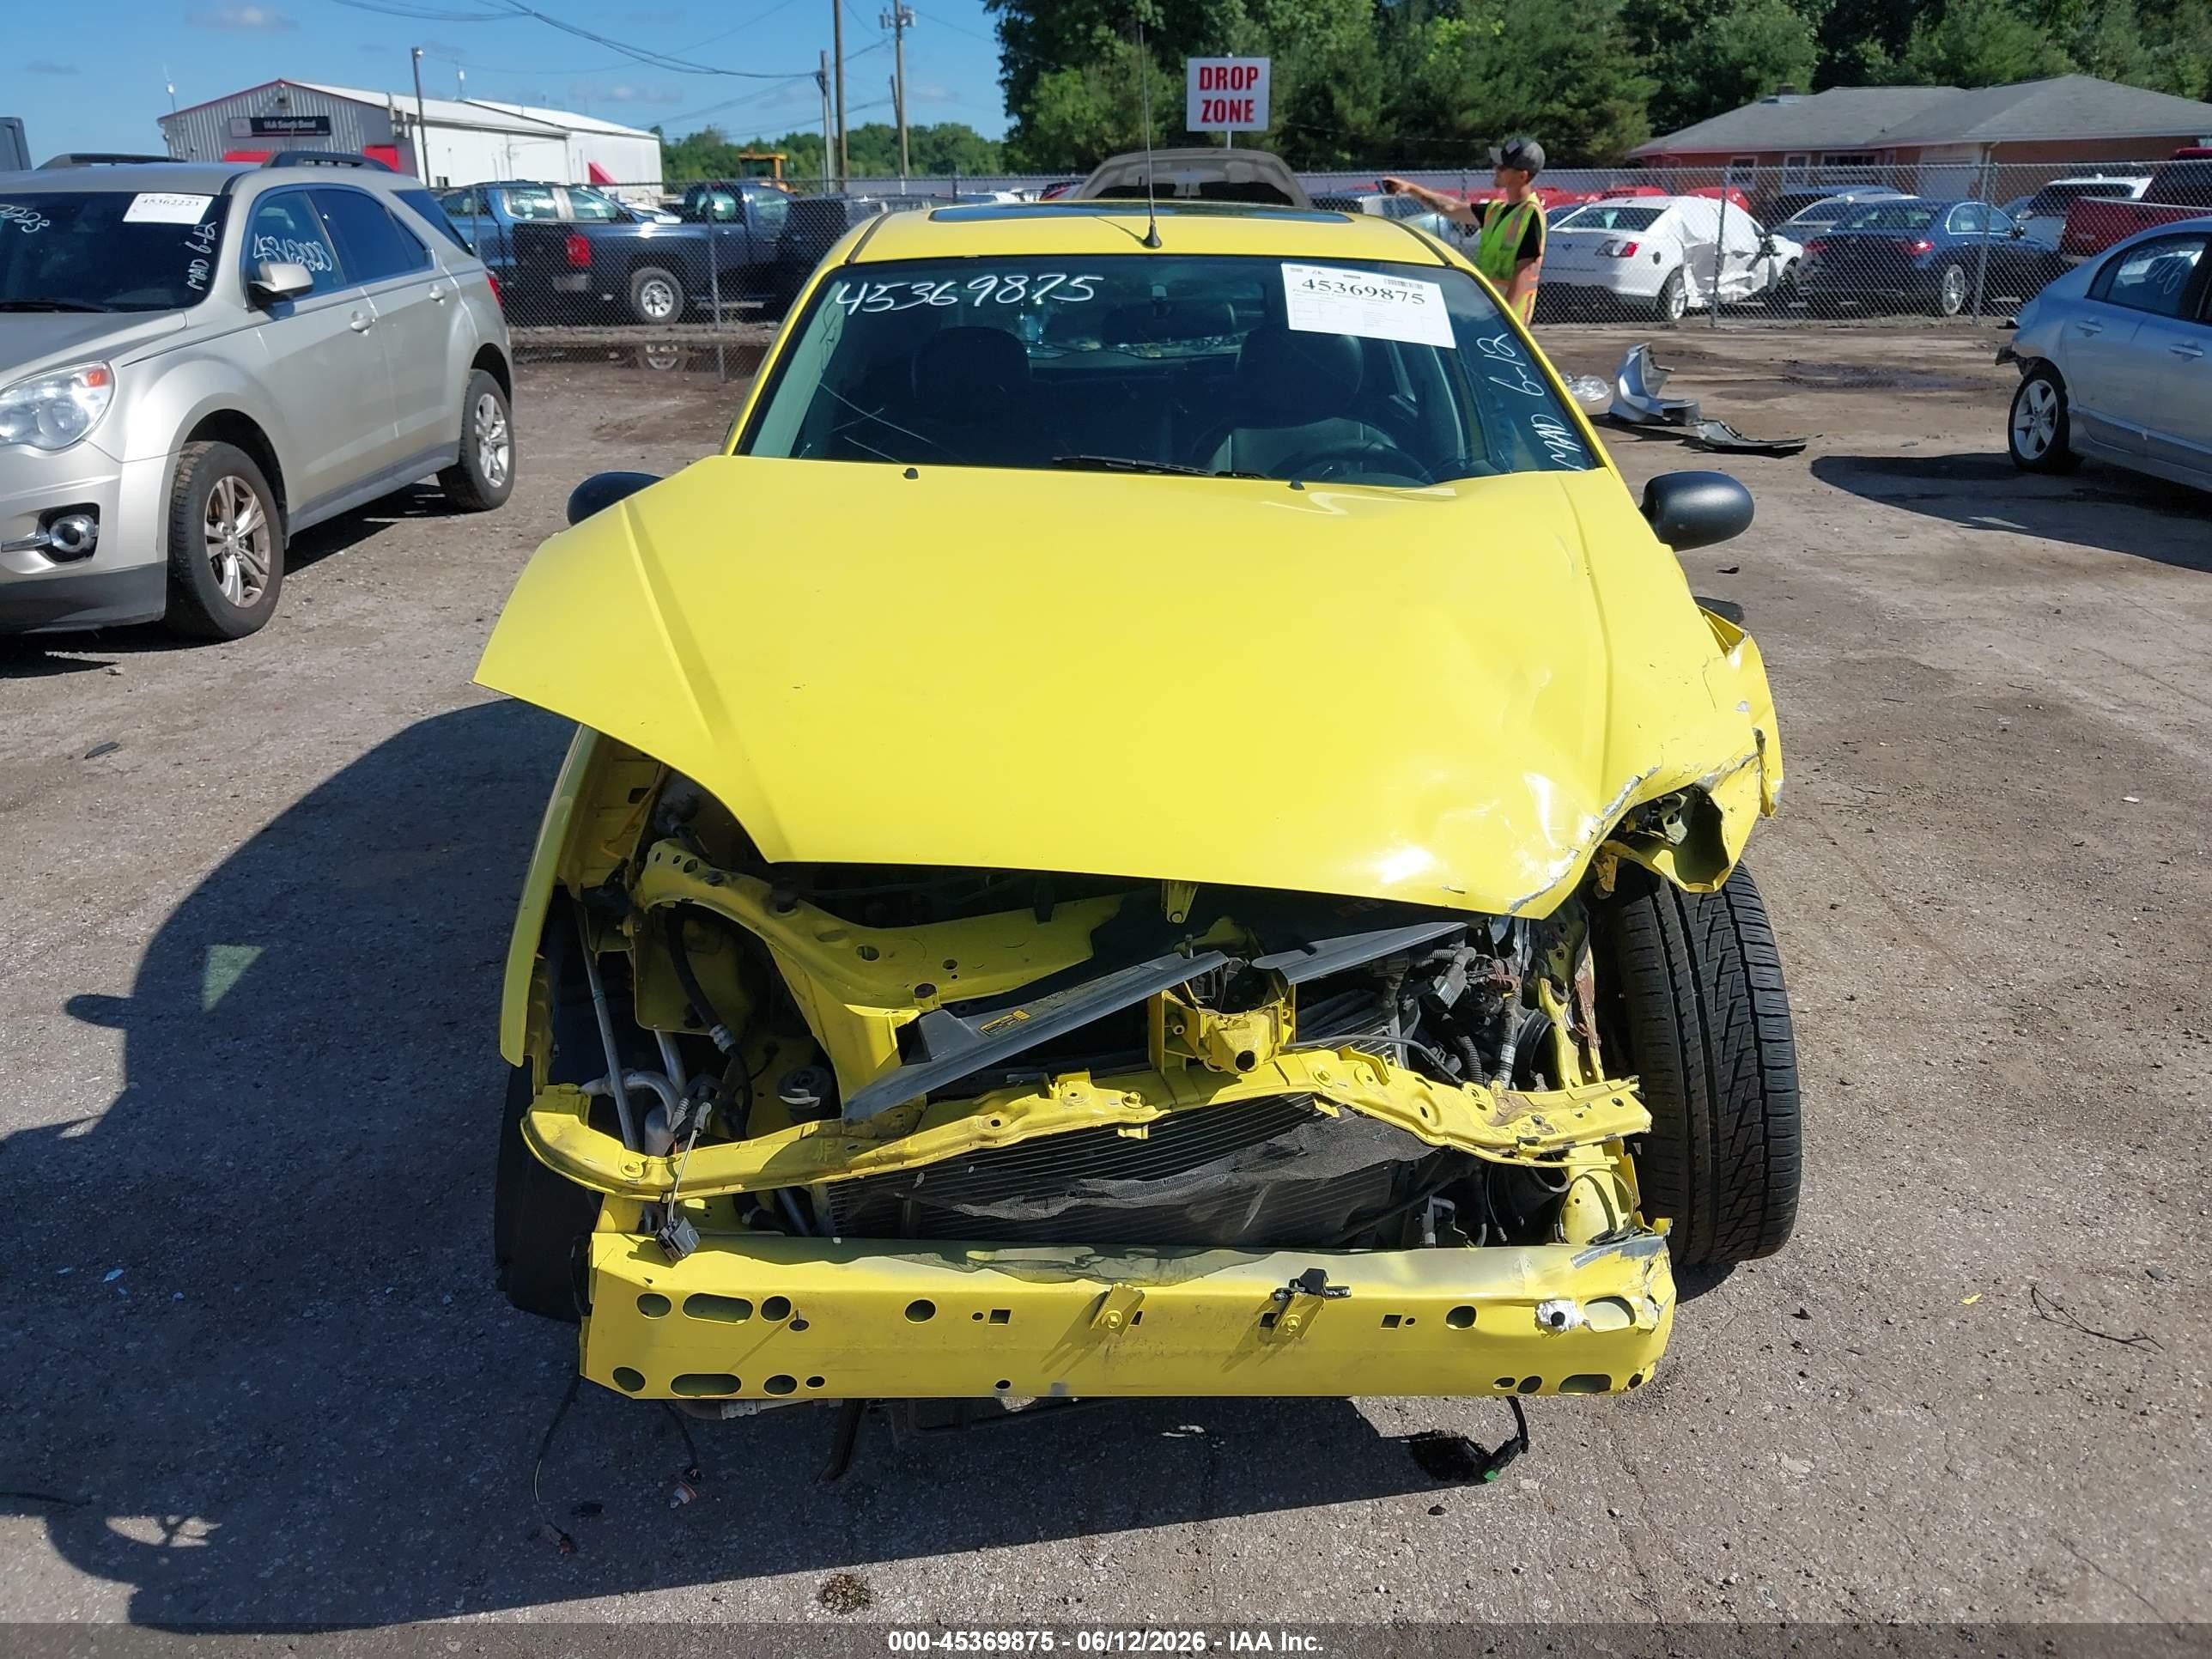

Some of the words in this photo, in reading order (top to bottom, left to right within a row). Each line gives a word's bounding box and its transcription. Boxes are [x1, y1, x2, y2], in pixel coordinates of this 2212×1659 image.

[1200, 66, 1258, 90] DROP
[1201, 99, 1255, 123] ZONE
[835, 272, 1105, 316] 45369875
[1302, 278, 1425, 306] 45369875
[1476, 333, 1545, 397] 6-12
